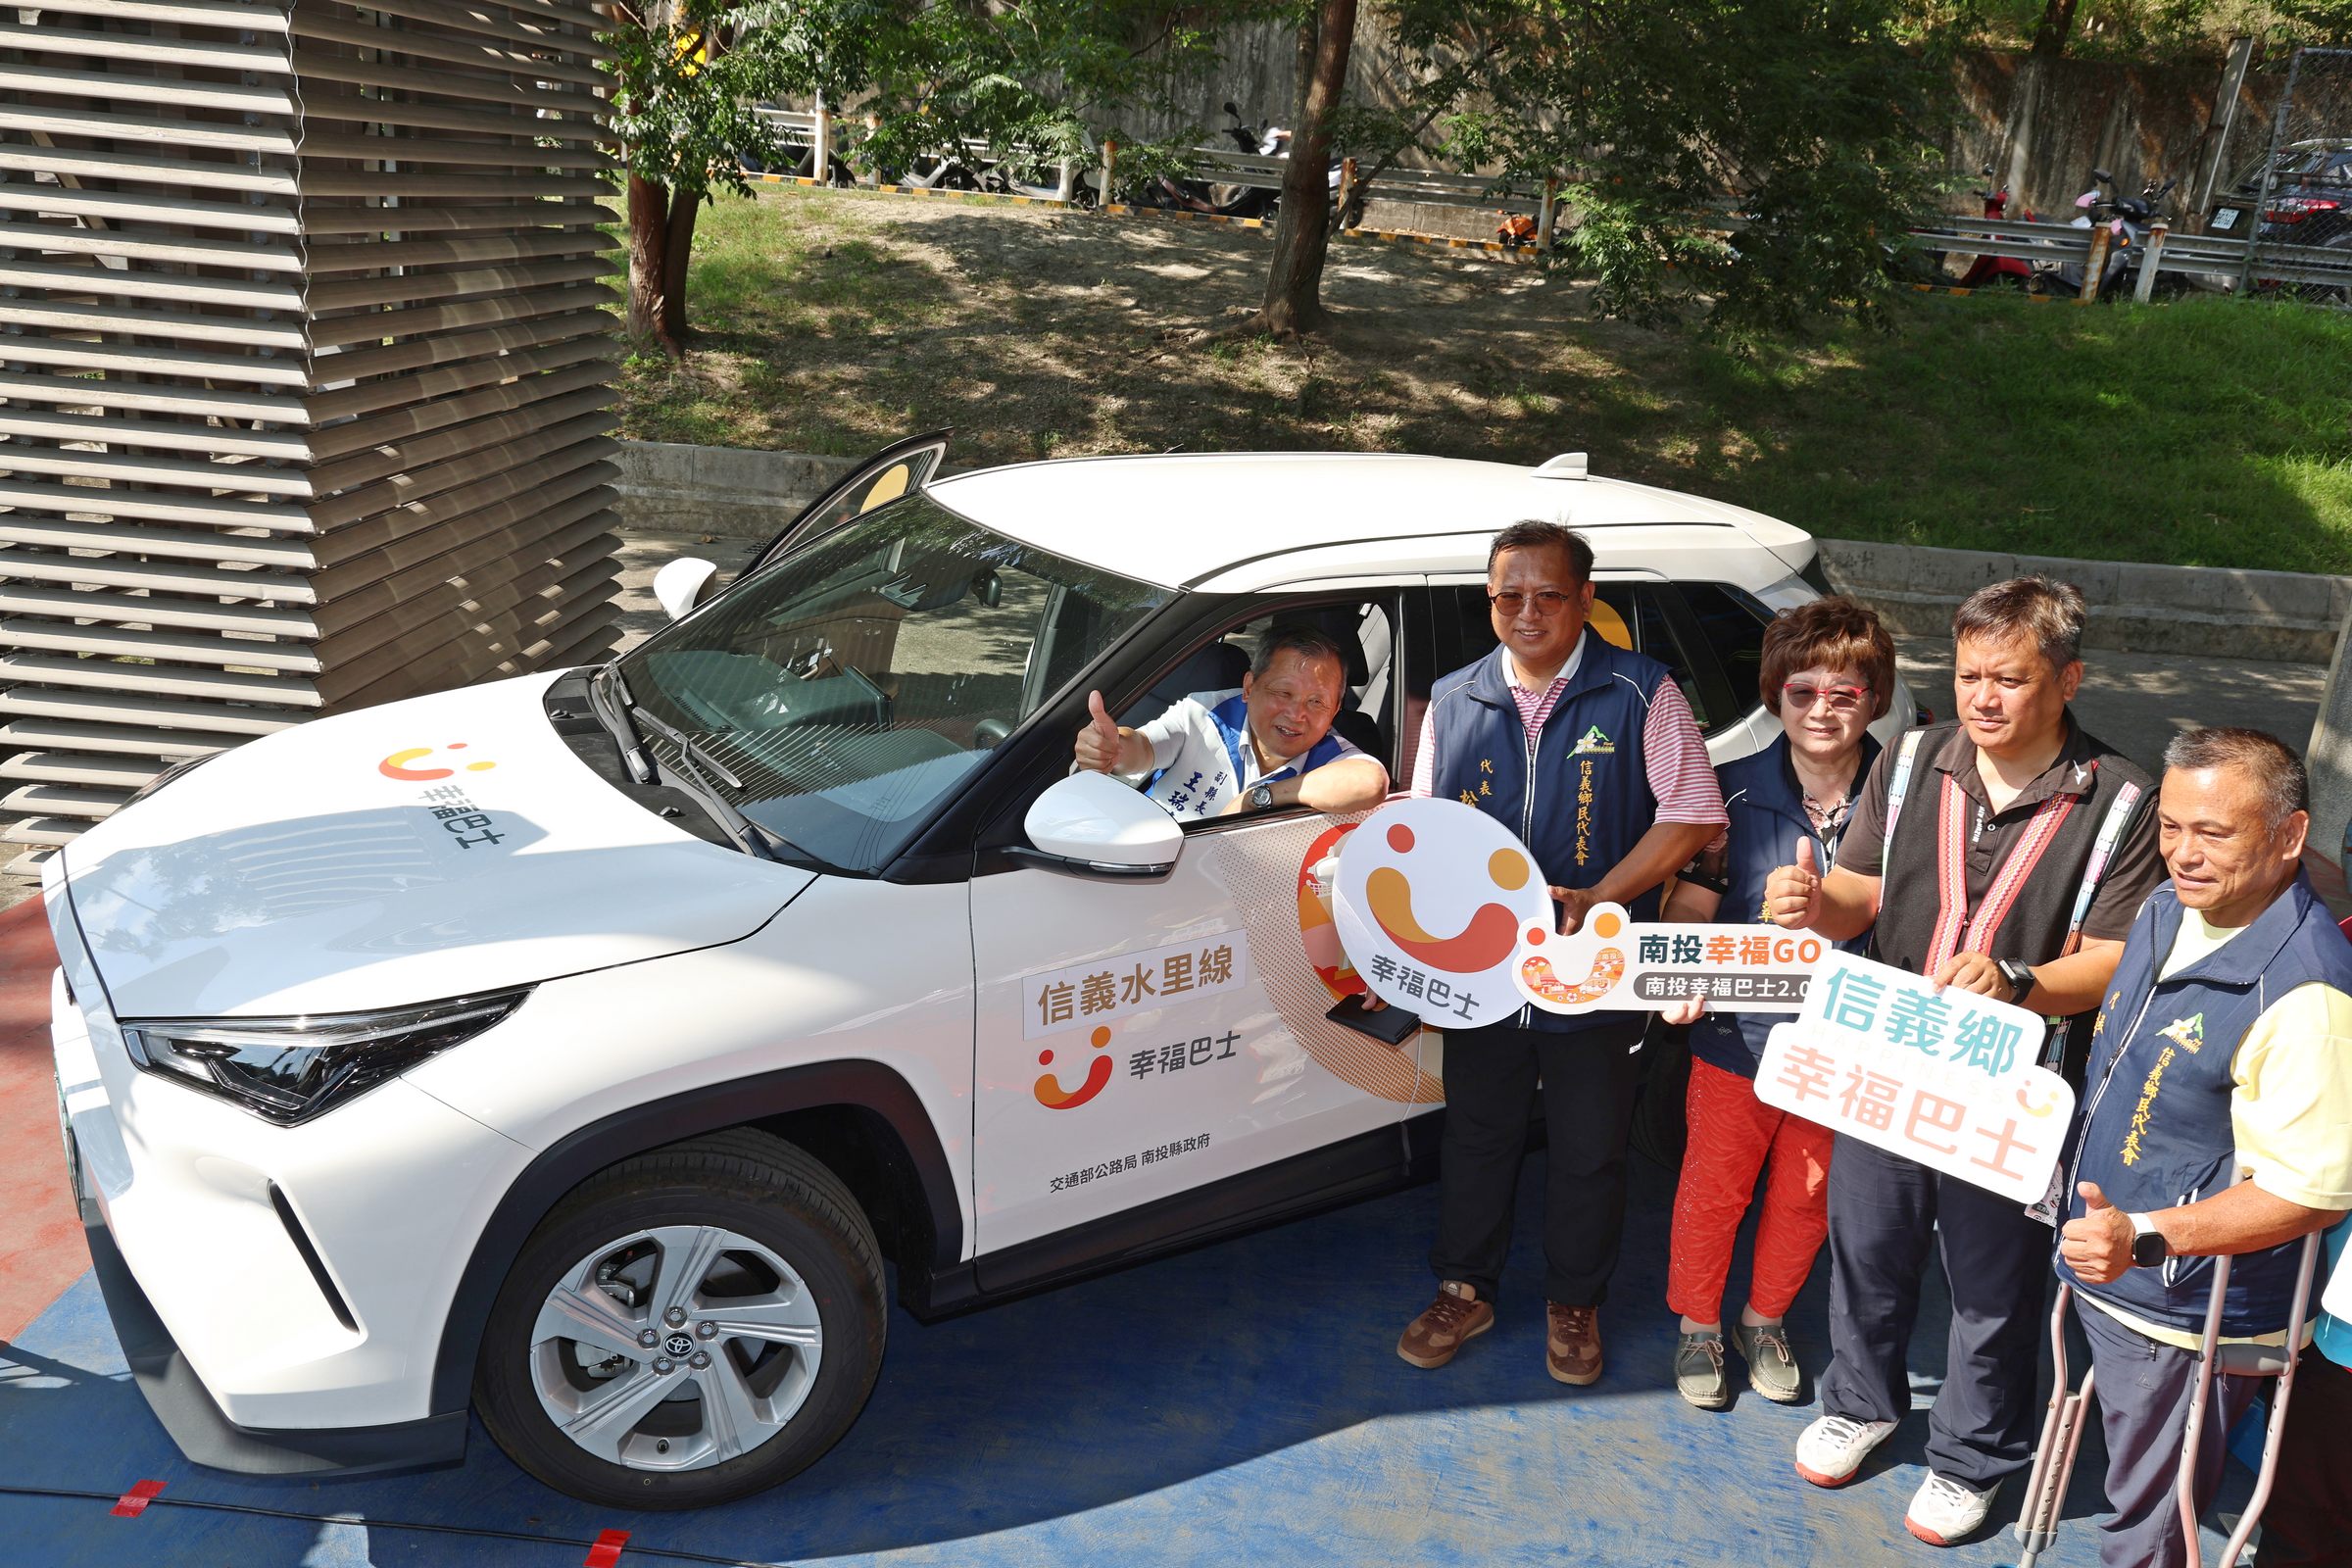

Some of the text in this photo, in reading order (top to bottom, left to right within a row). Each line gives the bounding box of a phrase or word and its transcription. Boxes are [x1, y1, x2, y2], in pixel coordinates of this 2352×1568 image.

[1167, 770, 1203, 815] 王瑞
[1195, 770, 1228, 815] 副縣長
[1480, 759, 1494, 796] 代表
[417, 784, 506, 850] 幸福巴士
[1574, 760, 1594, 866] 信義鄉民代表會
[1638, 933, 1822, 965] 南投幸福GO
[1037, 943, 1234, 1026] 信義水里線
[1371, 954, 1481, 1021] 幸福巴士
[1644, 975, 1811, 999] 南投幸福巴士2.0
[1822, 966, 2025, 1078] 信義鄉
[1128, 1030, 1242, 1080] 幸福巴士
[1776, 1044, 2038, 1182] 幸福巴士
[2119, 1046, 2176, 1166] 信義鄉民代表會
[1050, 1132, 1211, 1194] 交通部公路局 南投縣政府
